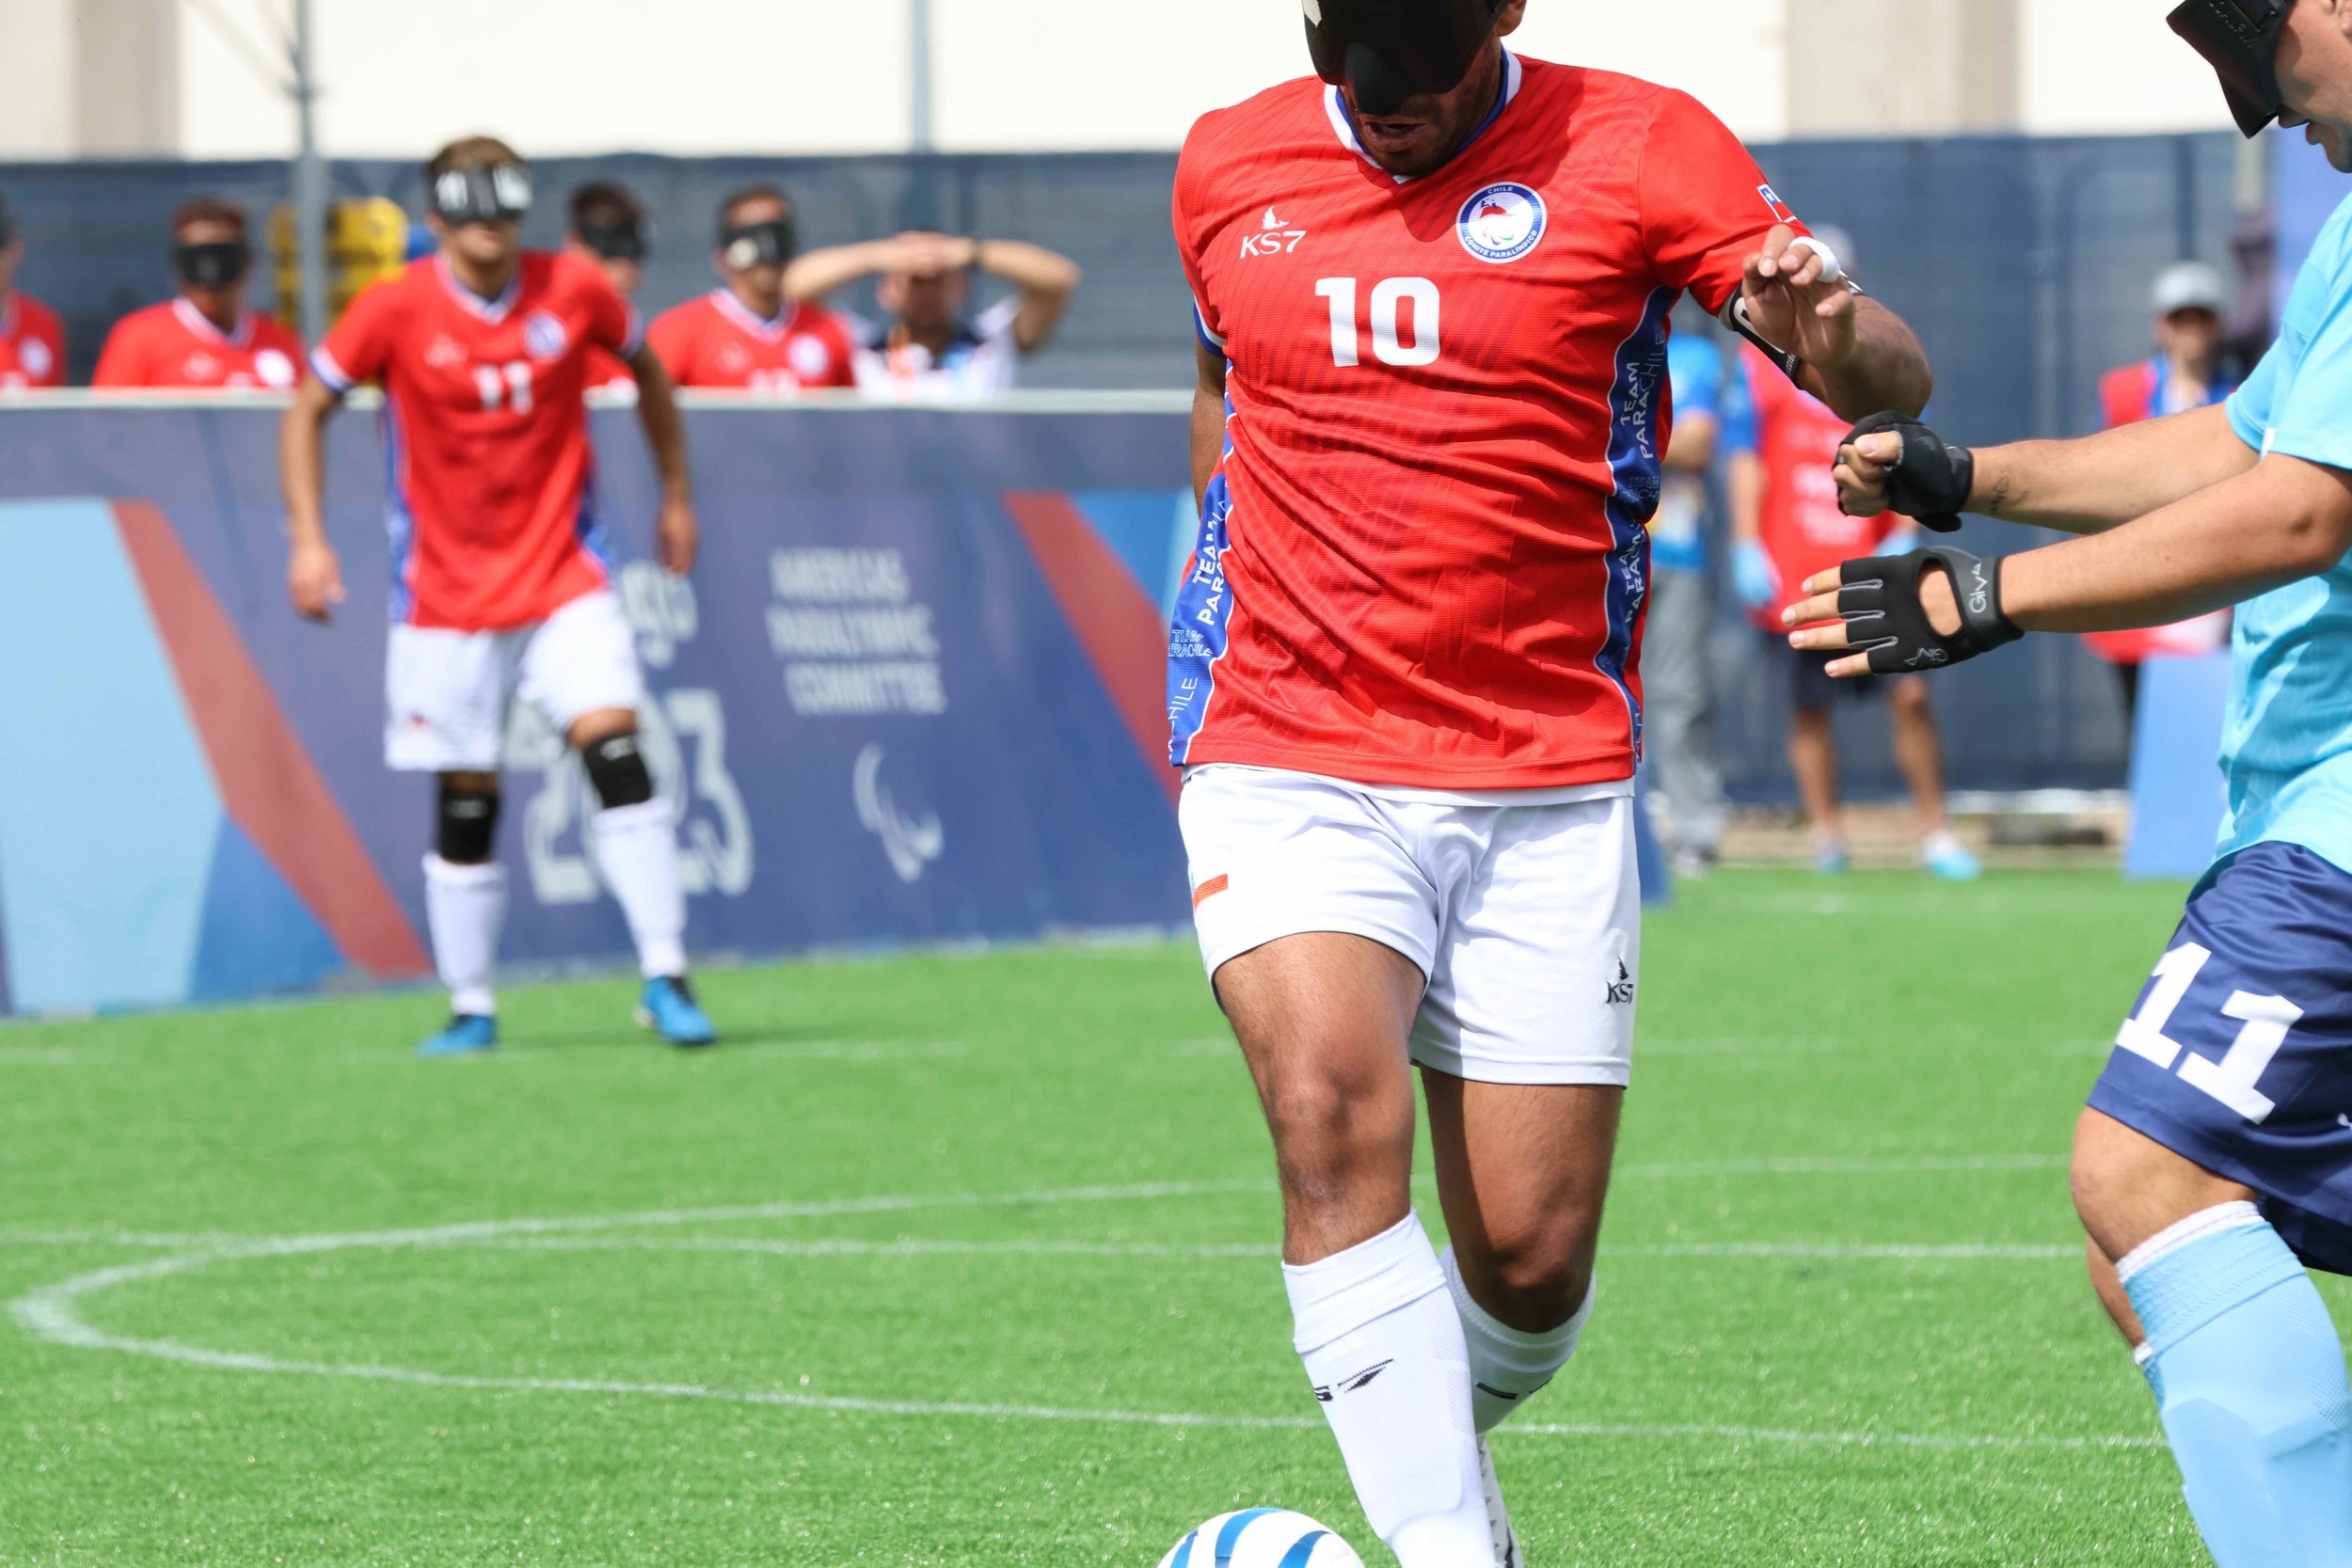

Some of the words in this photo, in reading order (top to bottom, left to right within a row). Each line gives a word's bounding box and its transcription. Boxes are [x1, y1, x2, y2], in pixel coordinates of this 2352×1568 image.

[1487, 186, 1514, 195] CHILE
[1240, 230, 1307, 260] KS7
[1315, 277, 1440, 367] 10
[1619, 362, 1640, 426] TEAM
[2115, 942, 2305, 1125] 11
